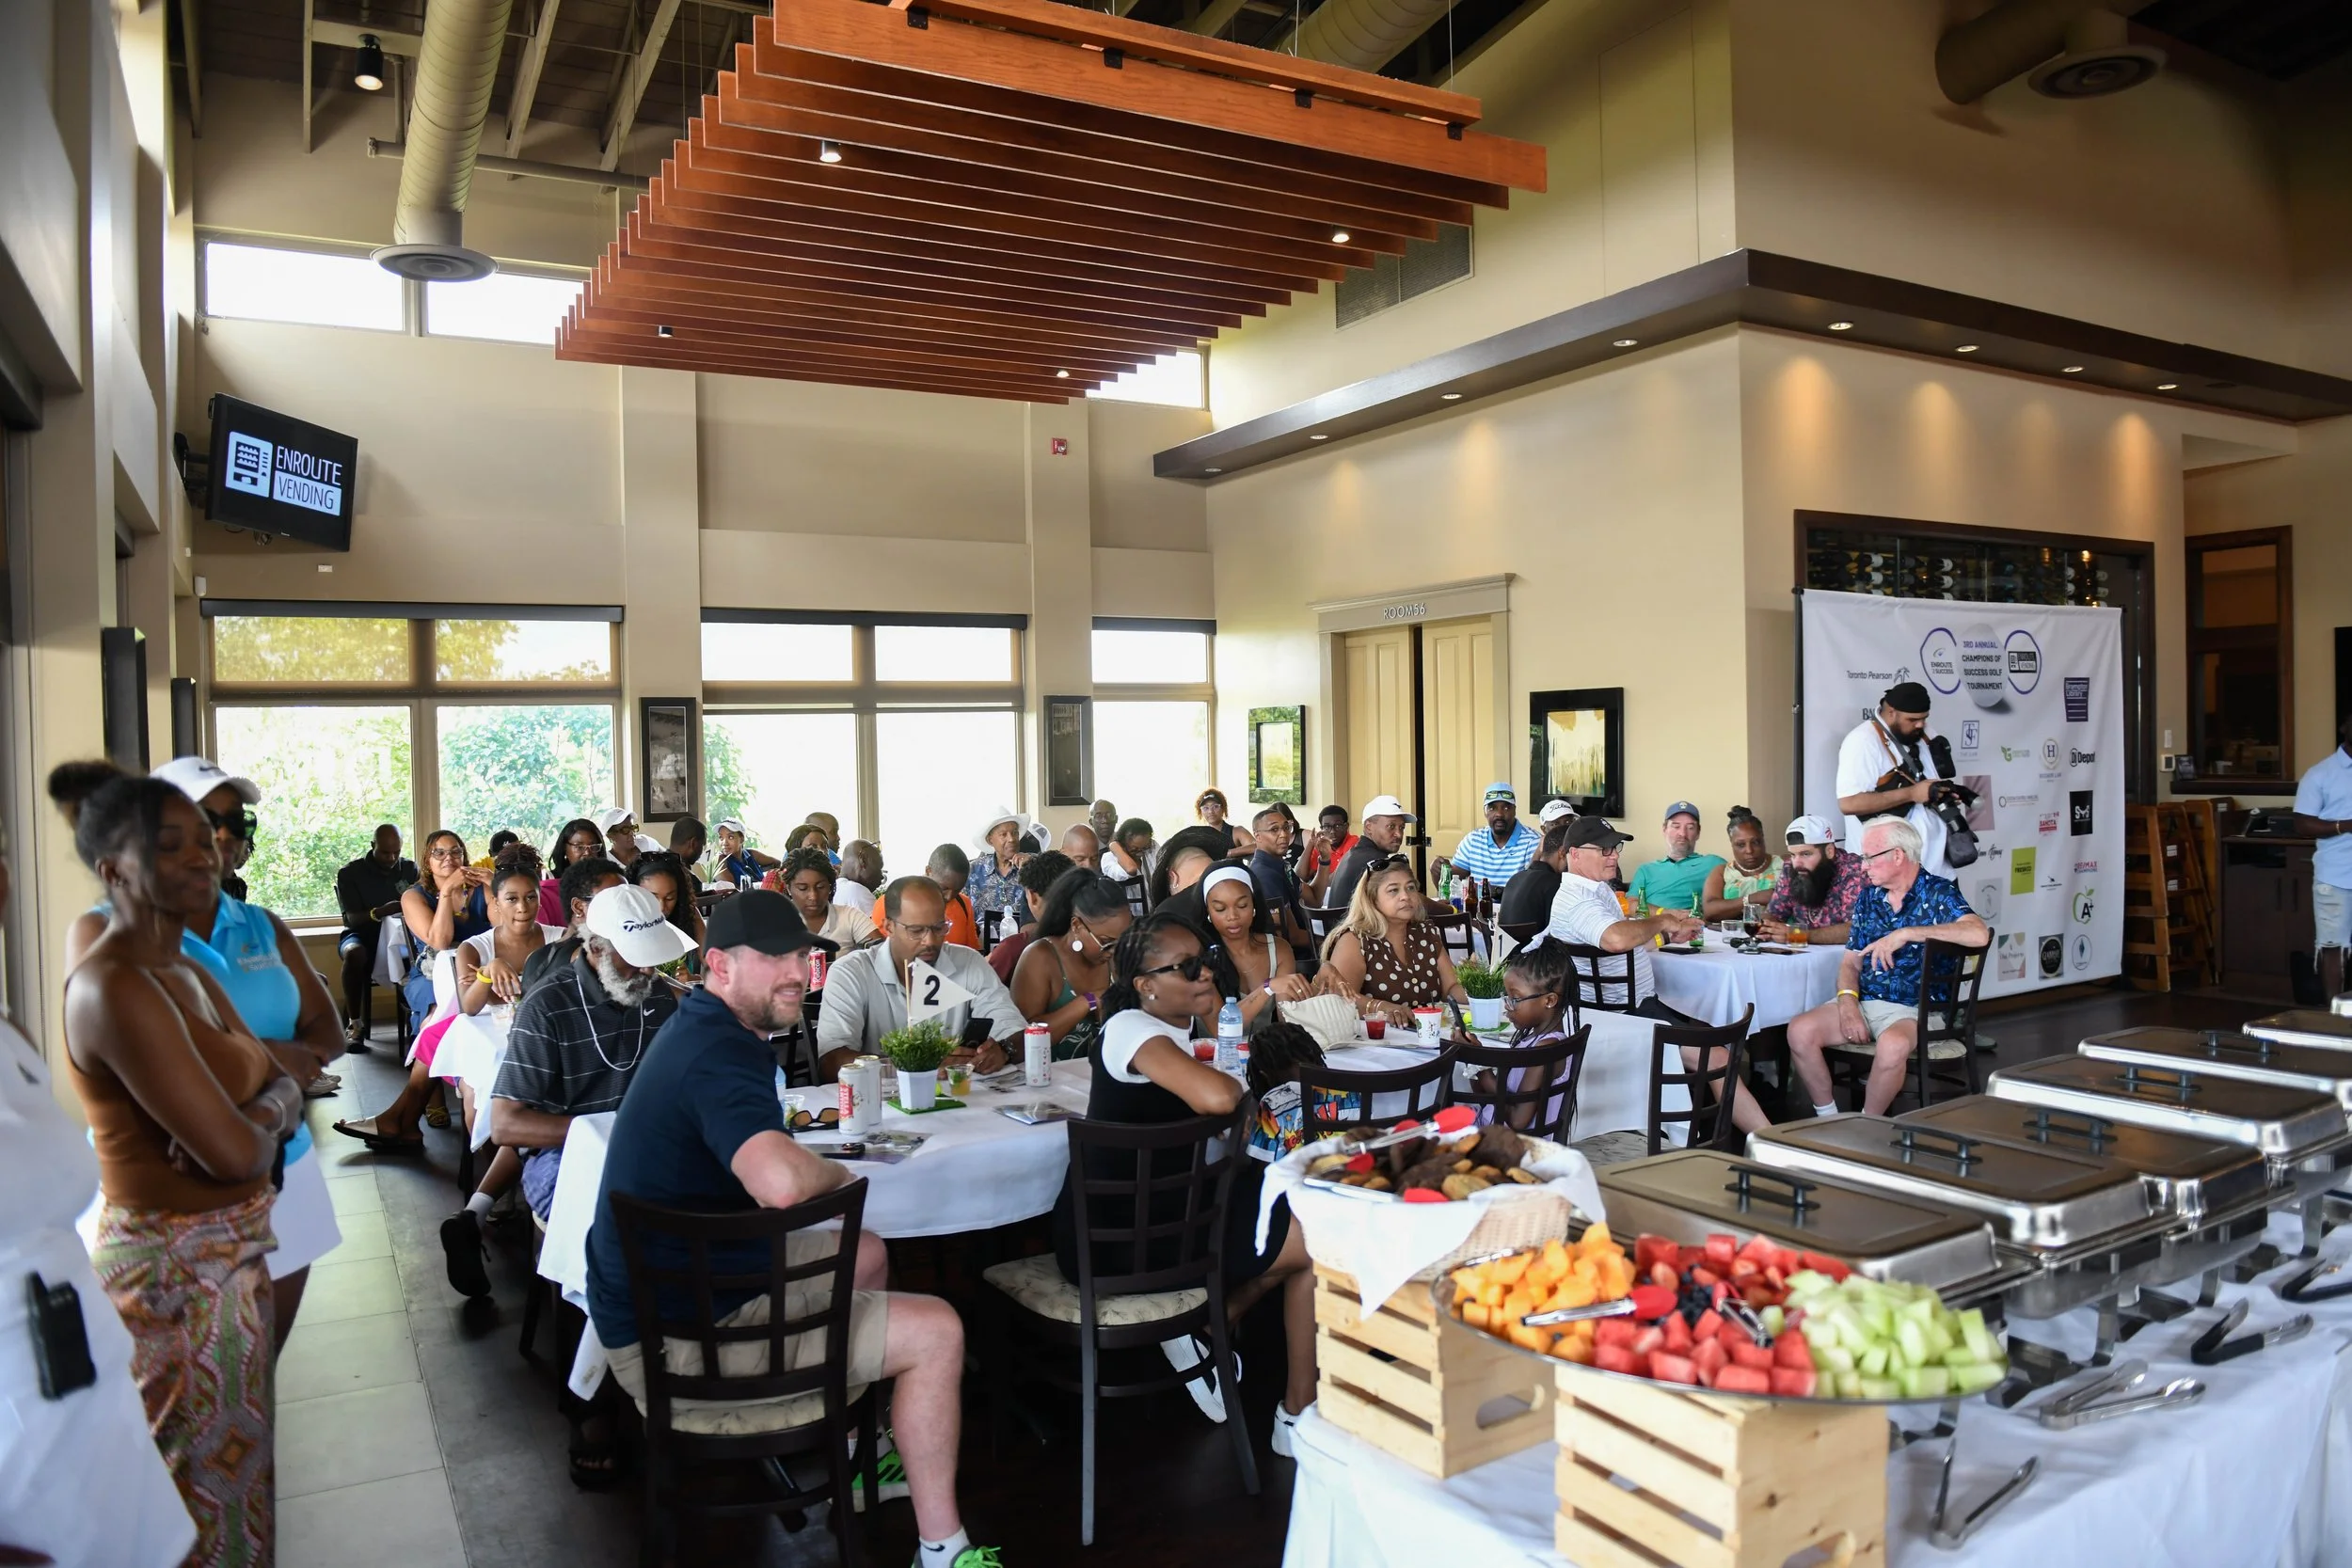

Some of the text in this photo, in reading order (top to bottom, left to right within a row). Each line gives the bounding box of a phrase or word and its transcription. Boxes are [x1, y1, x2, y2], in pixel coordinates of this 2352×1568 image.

[276, 445, 342, 485] ENROUTE
[278, 475, 334, 510] VENDING
[1846, 670, 1892, 680] Toronto Pearson
[706, 849, 711, 862] 7
[1498, 934, 1503, 958] 1
[812, 959, 823, 984] Rubicon
[923, 974, 940, 1006] 2
